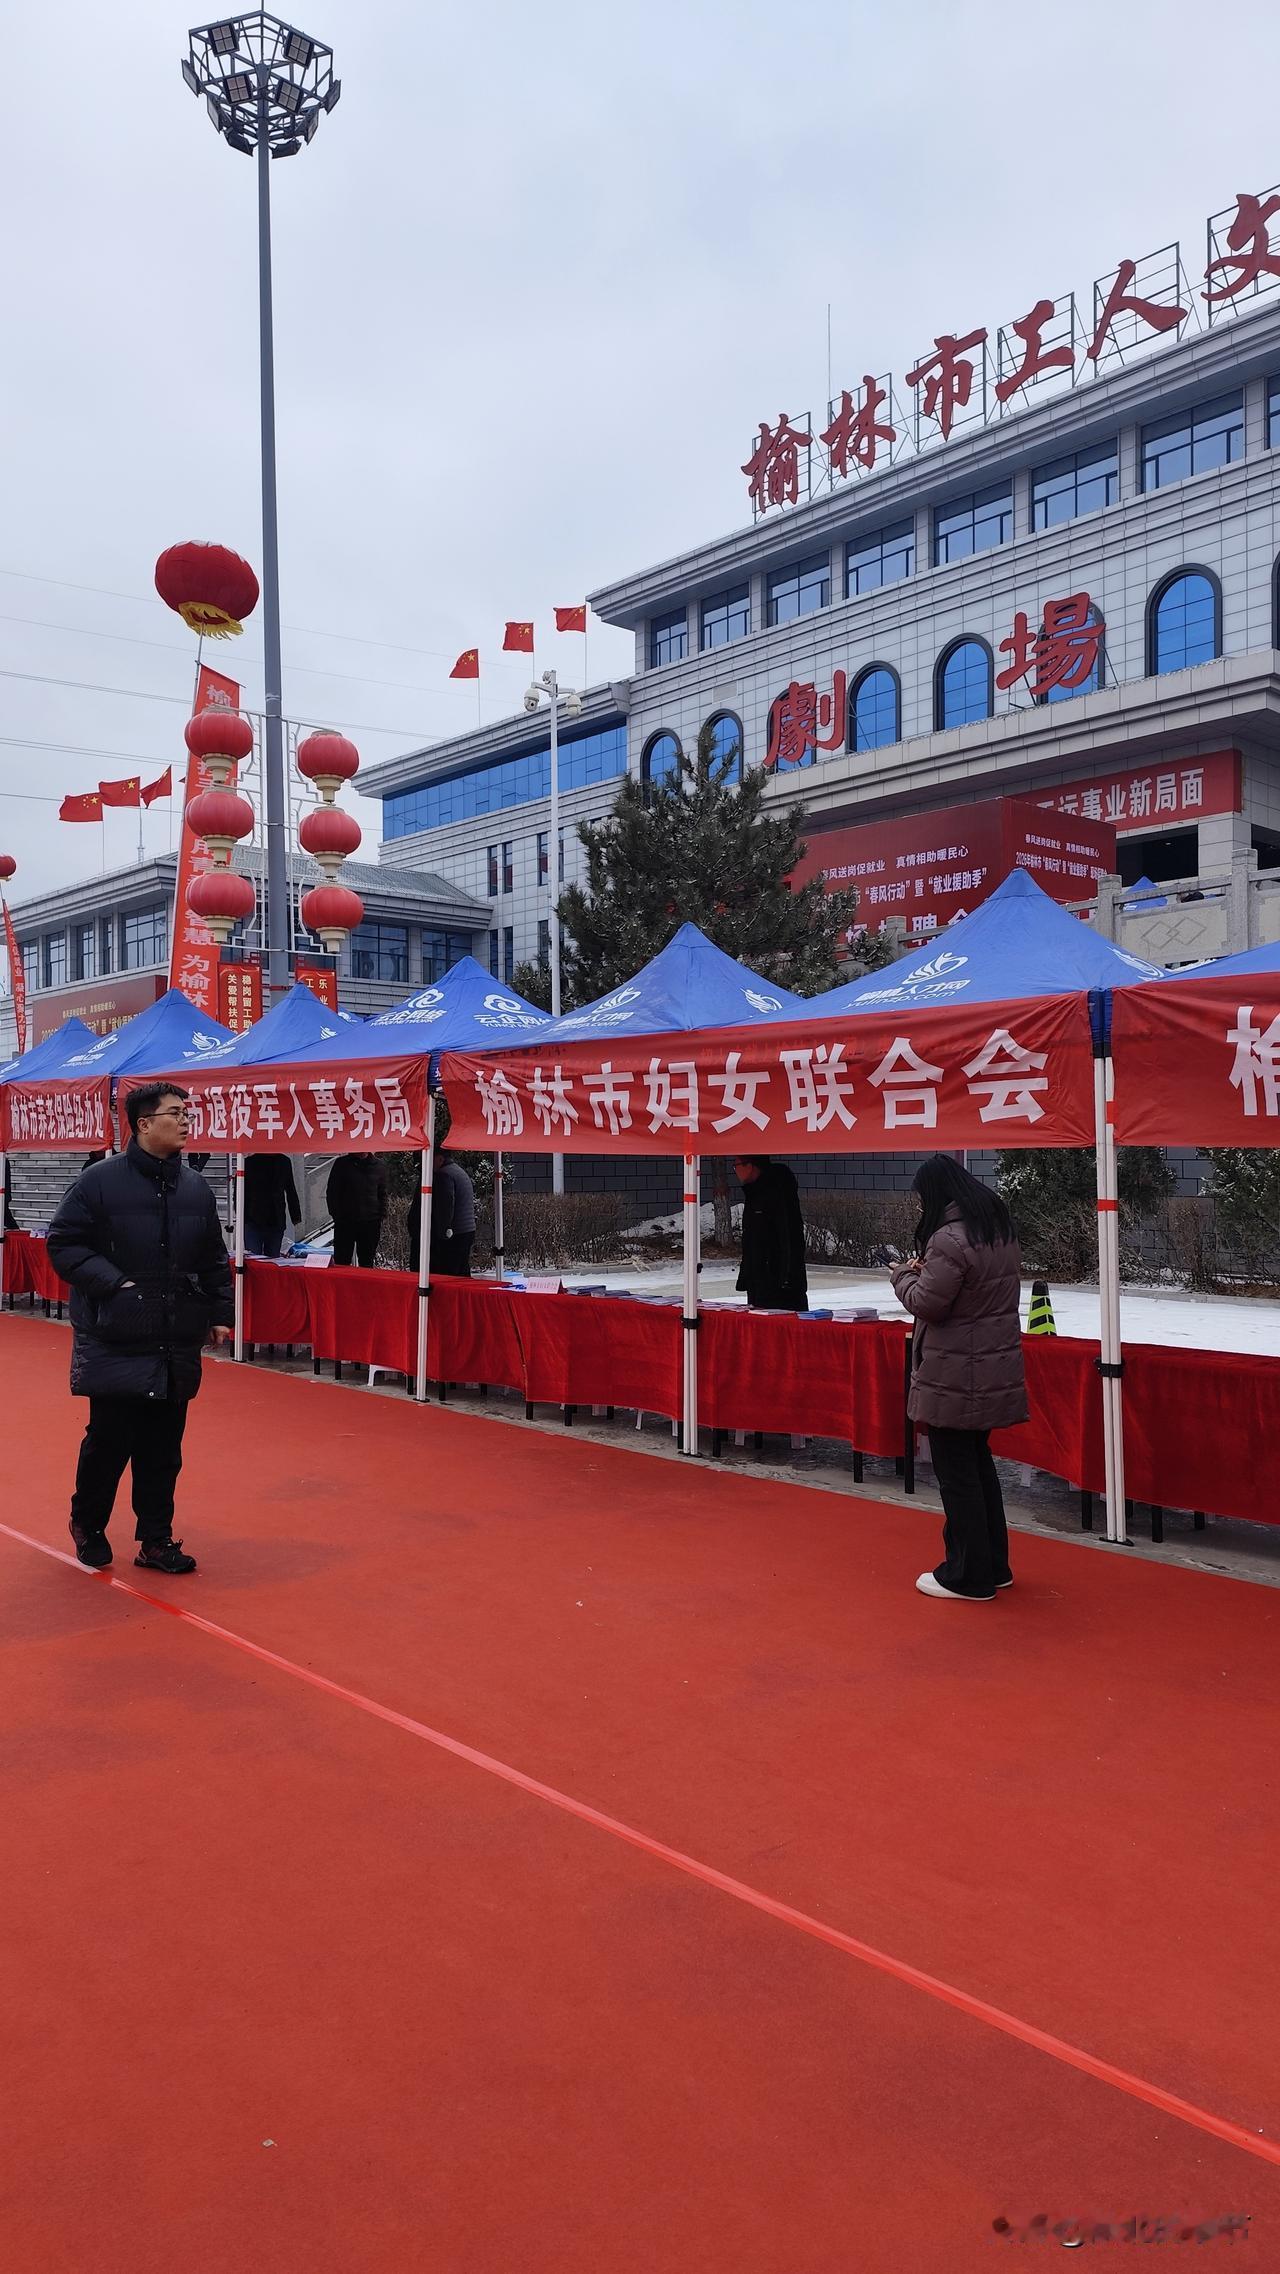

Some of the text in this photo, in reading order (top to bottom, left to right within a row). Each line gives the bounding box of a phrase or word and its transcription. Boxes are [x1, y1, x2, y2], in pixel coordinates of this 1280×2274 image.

[741, 193, 1280, 514] 榆林市工人文
[764, 591, 1106, 769] 劇場
[1036, 767, 1205, 823] 运事业新局面
[895, 845, 969, 869] 真情相助暖民心
[227, 974, 238, 1034] 关爱帮扶促
[184, 1077, 411, 1141] 市退役军人事务局
[475, 1028, 1050, 1137] 榆林市妇女联合会
